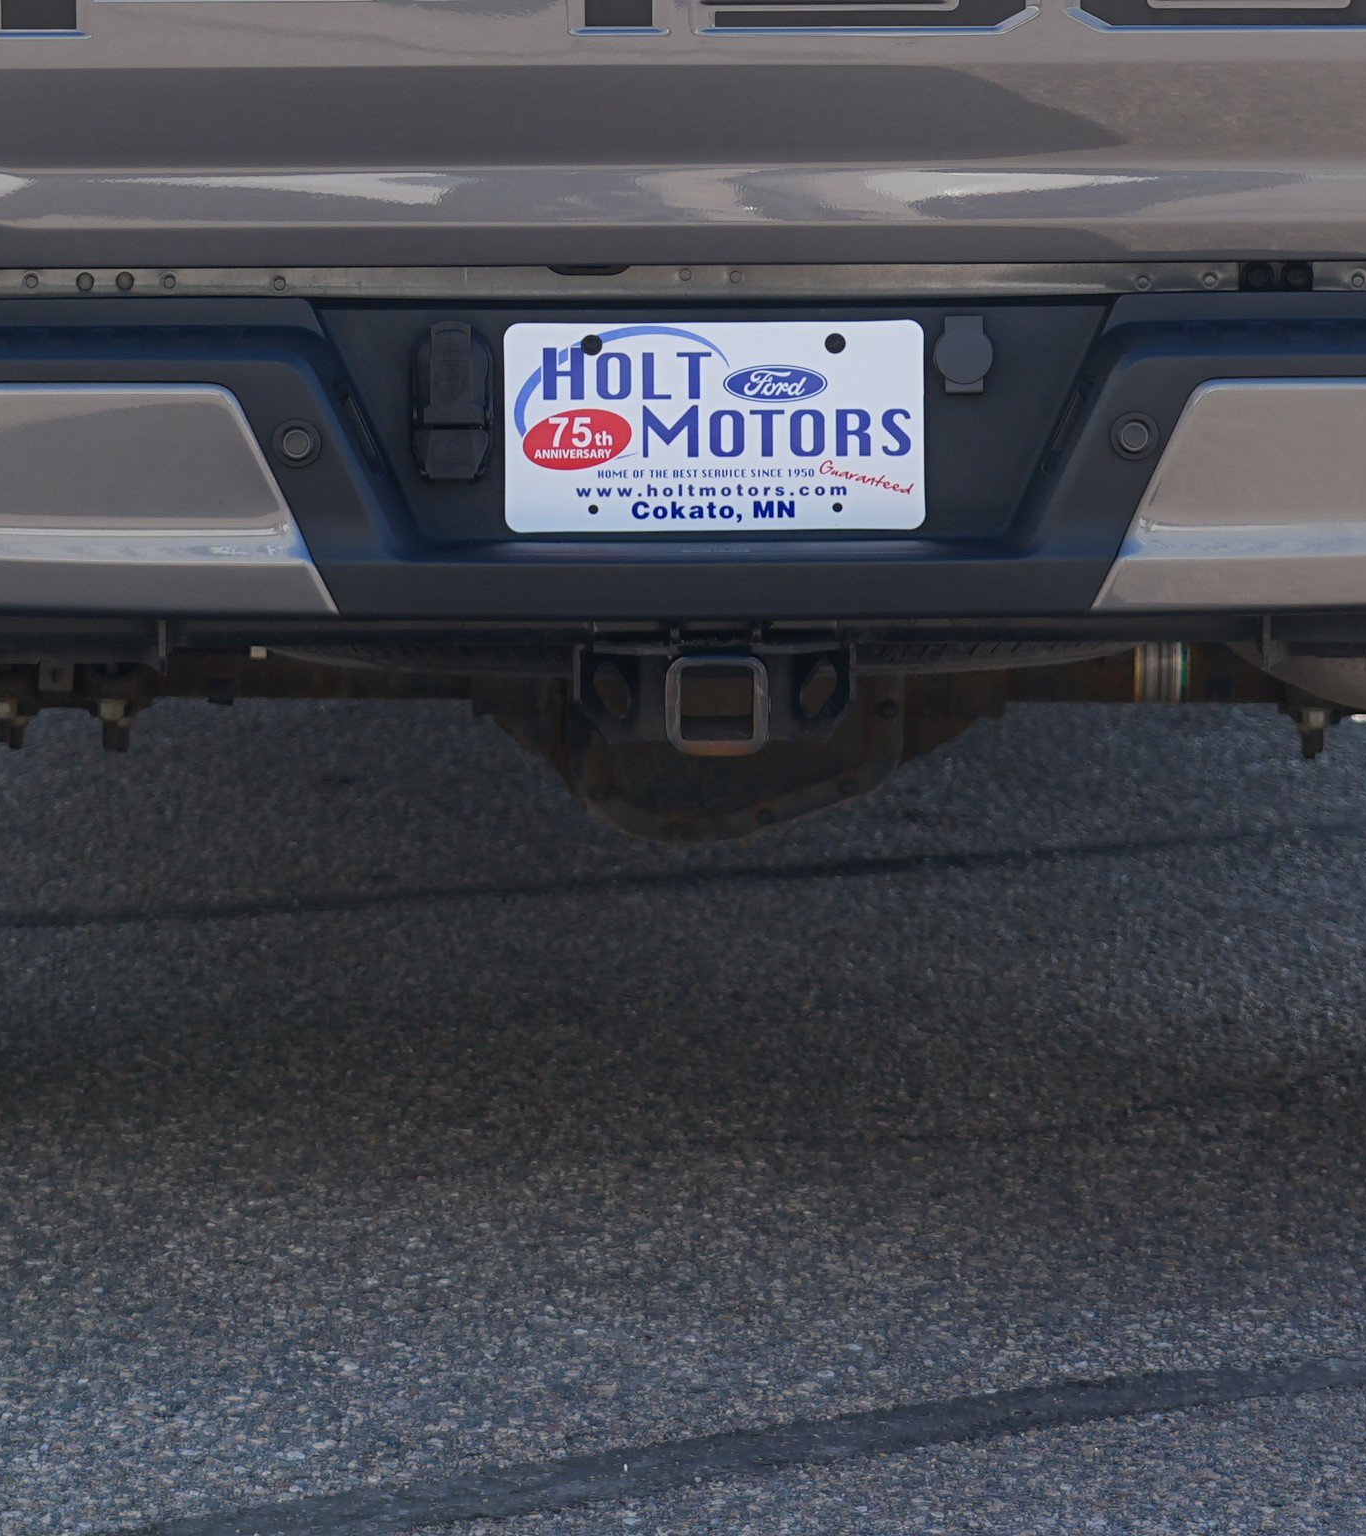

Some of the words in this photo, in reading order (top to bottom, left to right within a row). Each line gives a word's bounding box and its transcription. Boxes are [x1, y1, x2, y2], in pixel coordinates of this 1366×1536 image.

[542, 347, 712, 400] HOLT
[743, 369, 808, 397] Ford
[548, 416, 613, 448] 75th
[642, 404, 912, 458] MOTORS
[534, 448, 612, 460] ANNIVERSARY
[597, 469, 628, 479] HOME
[632, 469, 645, 479] OF
[649, 469, 669, 479] THE
[672, 469, 699, 478] BEST
[702, 468, 747, 478] SERVICE
[751, 468, 782, 478] SINCE
[788, 468, 815, 478] 1950
[819, 460, 914, 495] Guaranteed
[576, 483, 848, 498] www.holtmotors.com
[631, 500, 742, 523] Cokato,
[752, 500, 795, 518] MN
